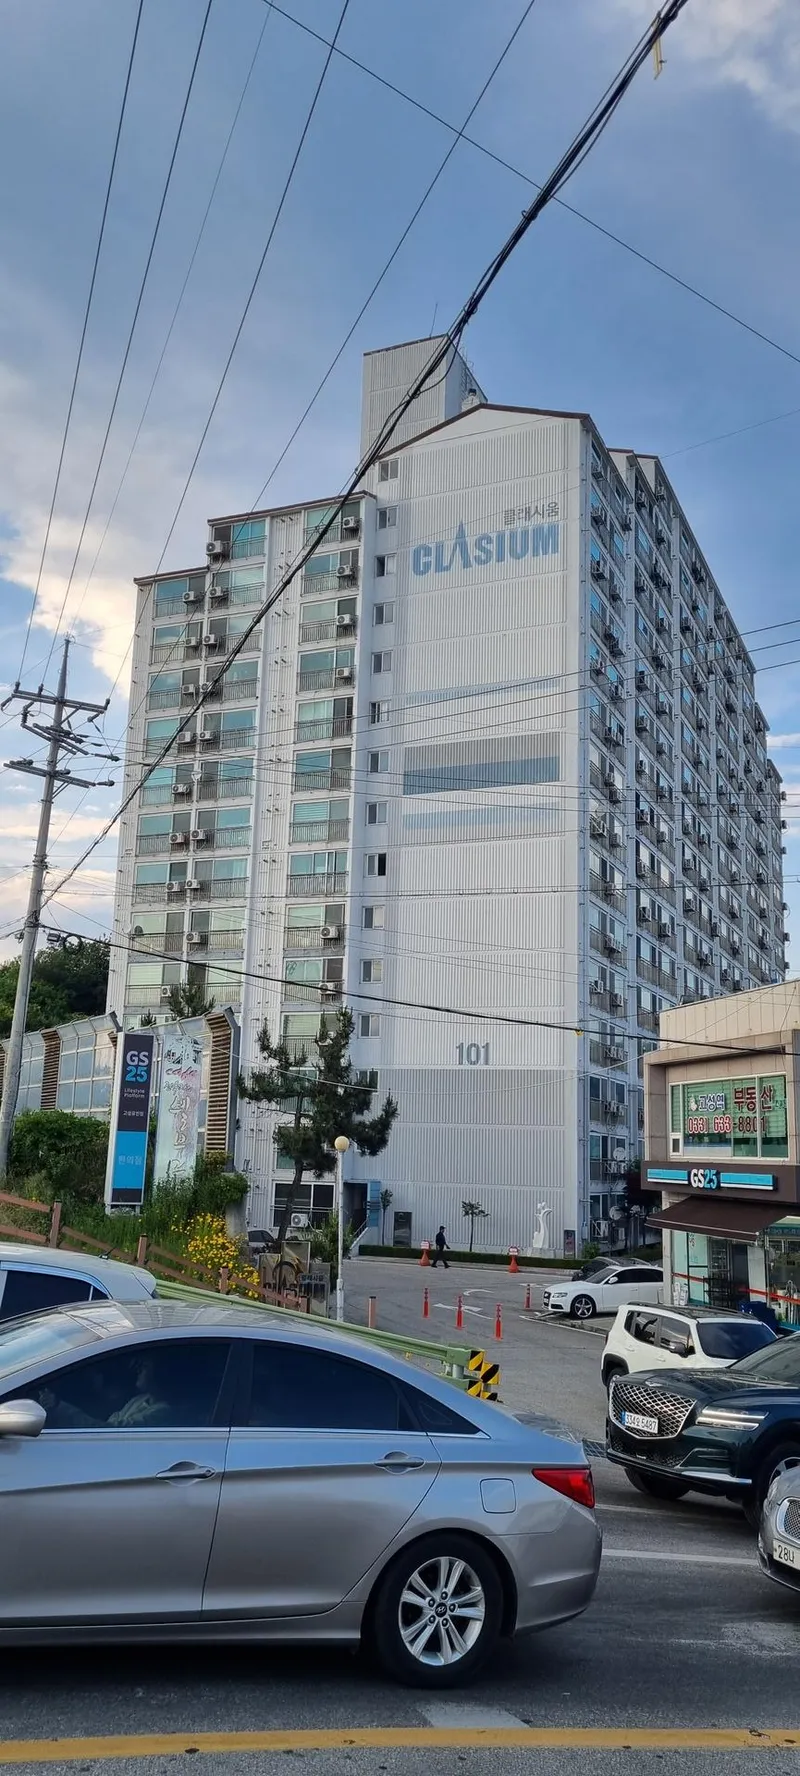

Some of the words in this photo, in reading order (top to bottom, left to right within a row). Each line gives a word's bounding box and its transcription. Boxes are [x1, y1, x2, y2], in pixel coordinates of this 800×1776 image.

[503, 501, 560, 526] 클래시움
[412, 520, 561, 577] CLASIUM
[126, 1050, 149, 1066] GS
[456, 1042, 489, 1065] 101
[125, 1066, 148, 1082] 25
[698, 1093, 726, 1112] 고성역
[733, 1083, 774, 1112] 부동산
[118, 1155, 143, 1166] 편의점
[690, 1168, 718, 1189] GS25
